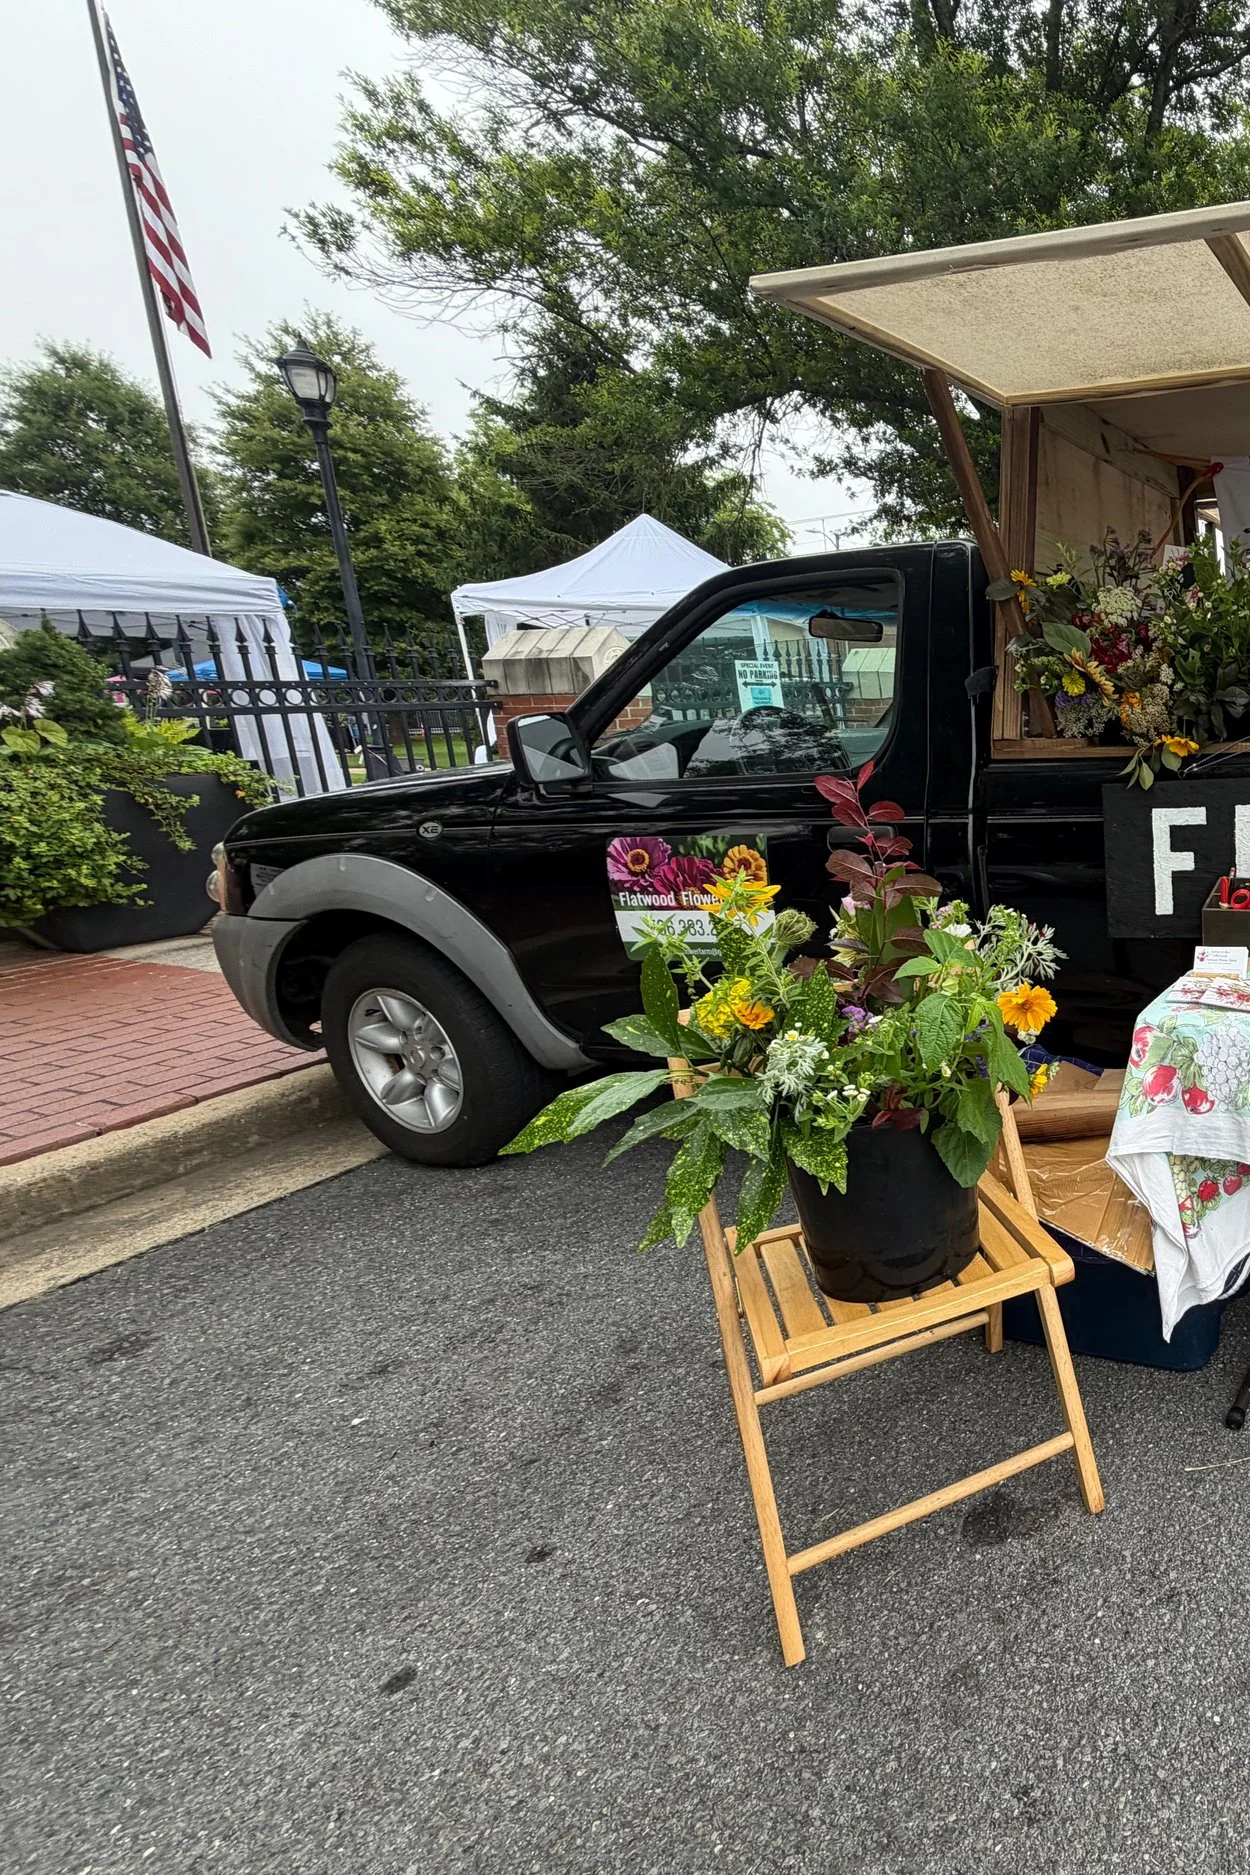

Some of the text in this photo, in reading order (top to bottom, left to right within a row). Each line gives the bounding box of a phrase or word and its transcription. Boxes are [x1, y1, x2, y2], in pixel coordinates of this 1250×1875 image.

[738, 670, 778, 679] NO PARKING
[421, 825, 440, 835] XE
[618, 891, 676, 907] Flatwood
